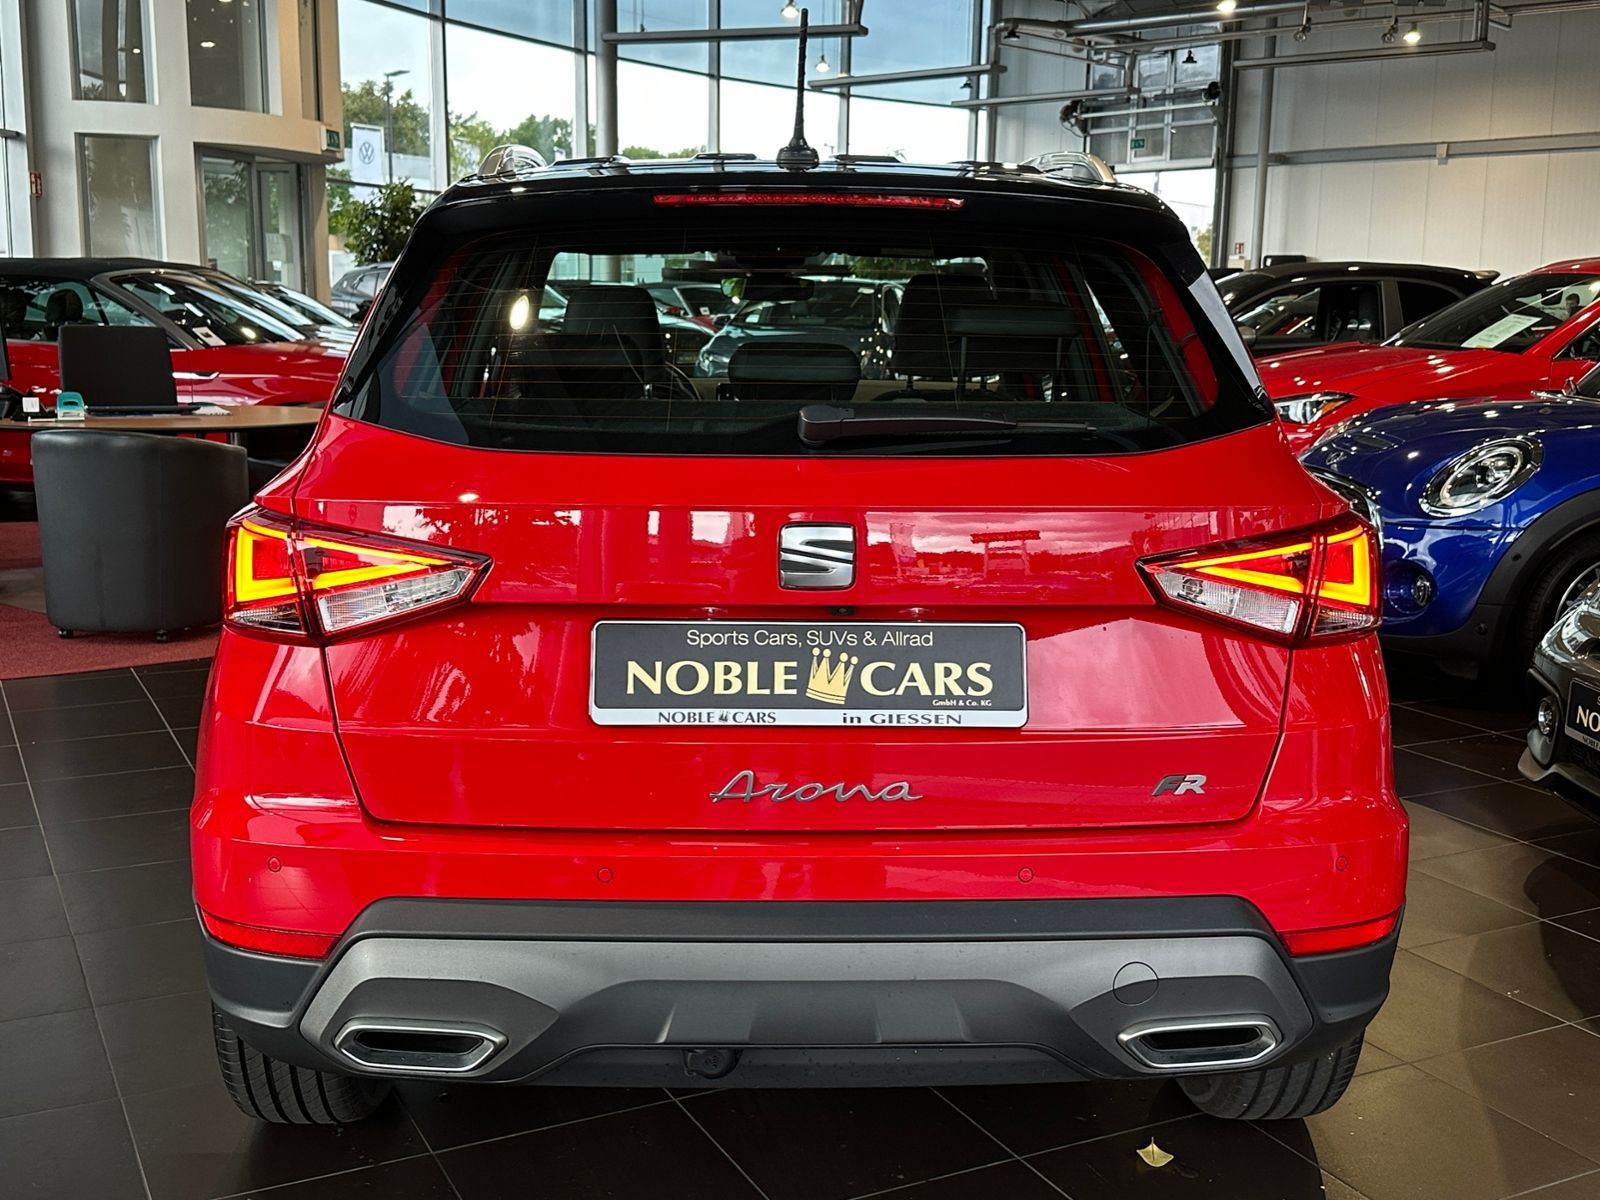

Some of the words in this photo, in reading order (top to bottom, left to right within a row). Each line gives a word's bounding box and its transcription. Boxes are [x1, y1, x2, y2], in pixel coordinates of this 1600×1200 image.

[687, 629, 748, 648] Sports
[754, 629, 802, 647] Cars,
[806, 629, 858, 647] SUVs
[863, 630, 876, 647] &
[881, 630, 933, 646] Allrad
[626, 660, 798, 696] NOBLE
[860, 660, 993, 696] CARS
[658, 712, 716, 723] NOBLE
[732, 712, 777, 723] CARS
[842, 713, 862, 724] in
[870, 714, 962, 724] GIESSEN
[710, 770, 923, 803] Arona
[1152, 774, 1206, 796] FR
